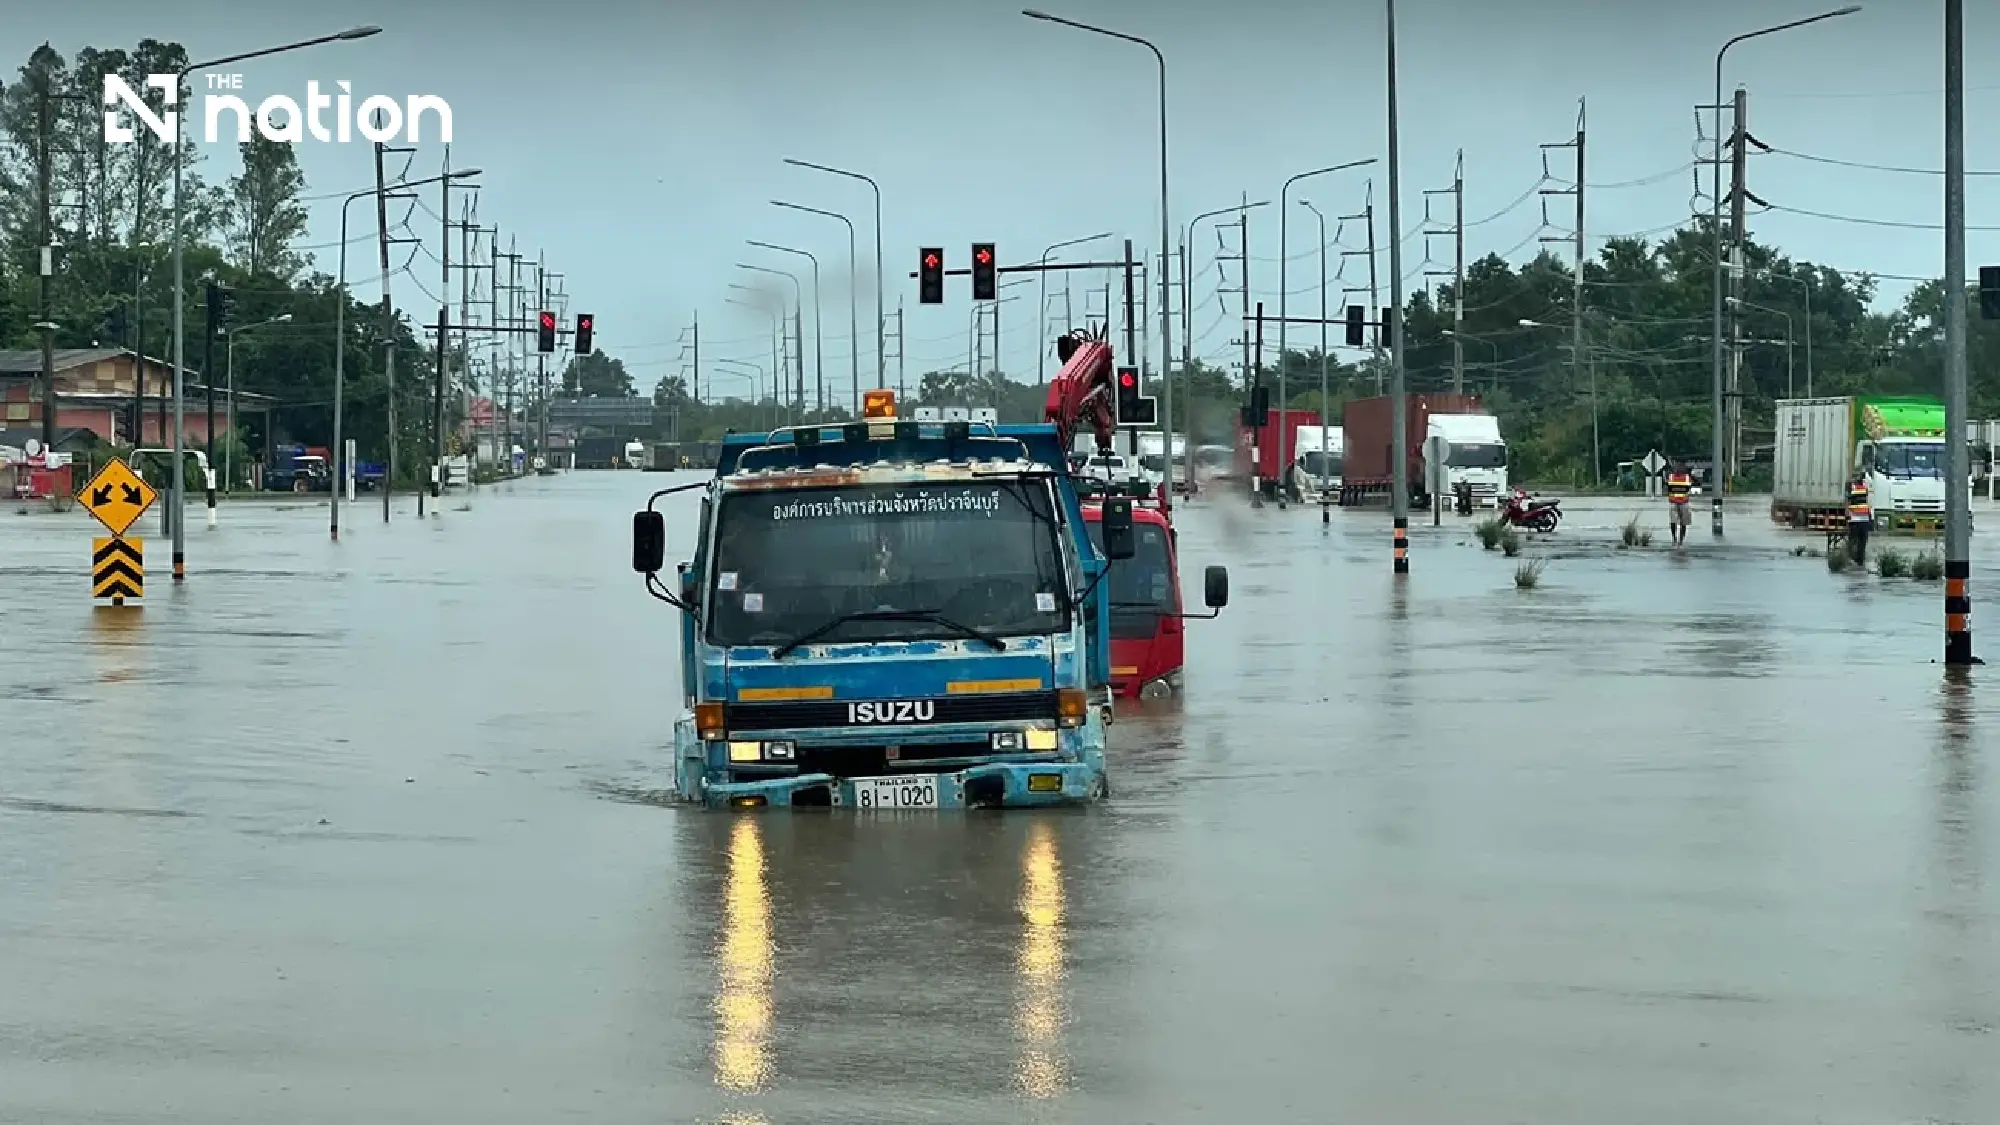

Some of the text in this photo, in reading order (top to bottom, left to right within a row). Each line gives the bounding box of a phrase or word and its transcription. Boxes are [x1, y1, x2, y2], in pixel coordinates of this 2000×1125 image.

[773, 490, 1000, 520] องค์การบริหารส่วนจังหวัดปราจีนบุรี
[848, 700, 935, 723] ISUZU
[861, 786, 935, 807] 81-1020
